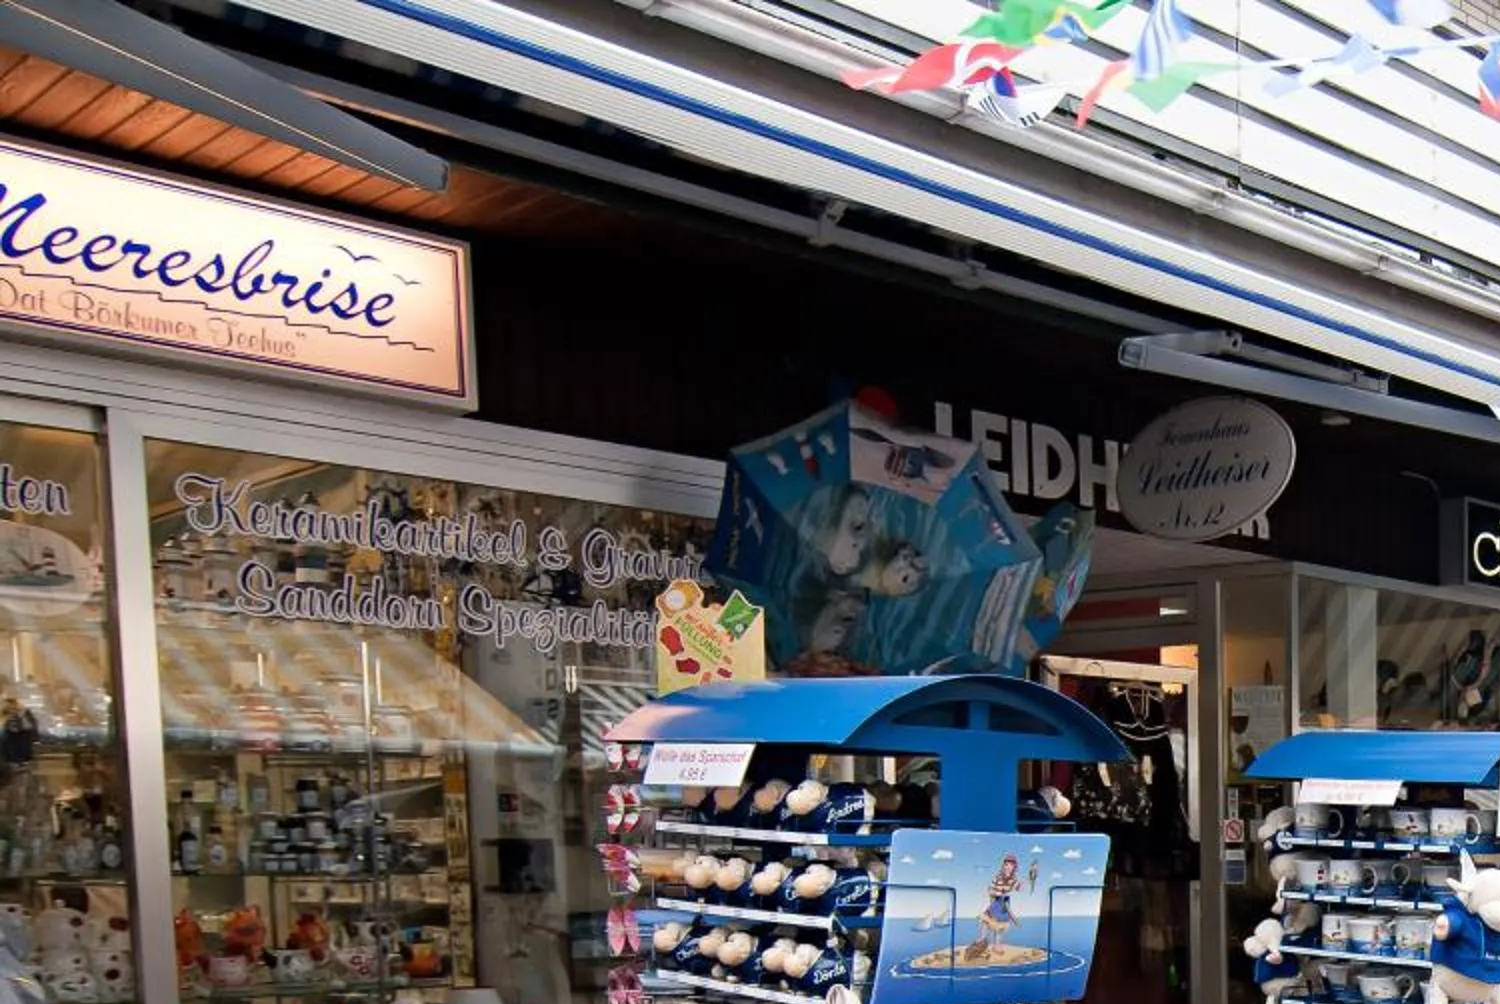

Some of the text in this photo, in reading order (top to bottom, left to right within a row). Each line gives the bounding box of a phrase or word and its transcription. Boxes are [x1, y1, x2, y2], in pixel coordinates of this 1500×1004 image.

[174, 471, 528, 568] Keramikartikel
[537, 526, 573, 571] &
[235, 558, 448, 631] Sanddorn
